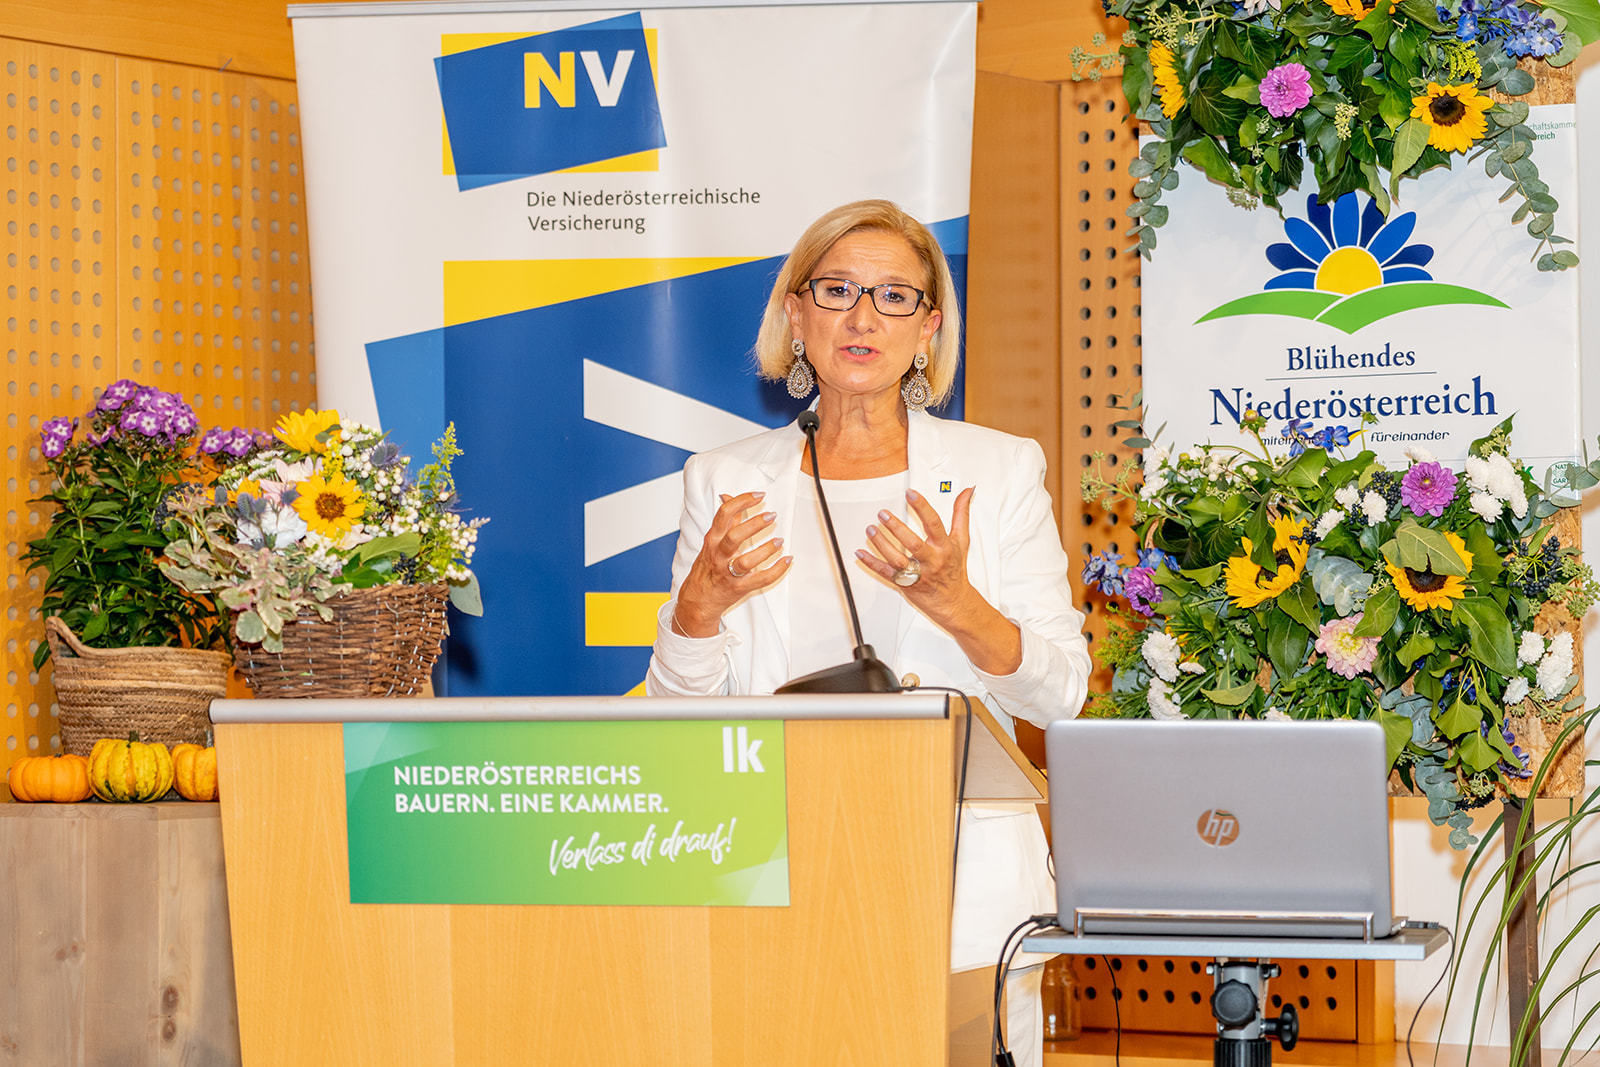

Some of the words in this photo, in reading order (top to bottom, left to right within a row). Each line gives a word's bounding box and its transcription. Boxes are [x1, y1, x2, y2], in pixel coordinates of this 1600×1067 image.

[524, 50, 635, 108] NV
[527, 191, 556, 207] Die
[563, 187, 761, 206] Niederösterreichische
[528, 214, 646, 234] Versicherung
[1286, 342, 1416, 370] Blühendes
[1209, 375, 1498, 425] Niederösterreich
[1371, 430, 1450, 442] füreinander
[394, 762, 641, 785] NIEDERÖSTERREICHS
[395, 793, 495, 813] BAUERN.
[500, 793, 553, 813] EINE
[559, 793, 669, 813] KAMMER.
[1203, 809, 1234, 846] hp
[549, 831, 626, 876] Verlass
[631, 823, 656, 866] di
[659, 817, 737, 864] drauf!
